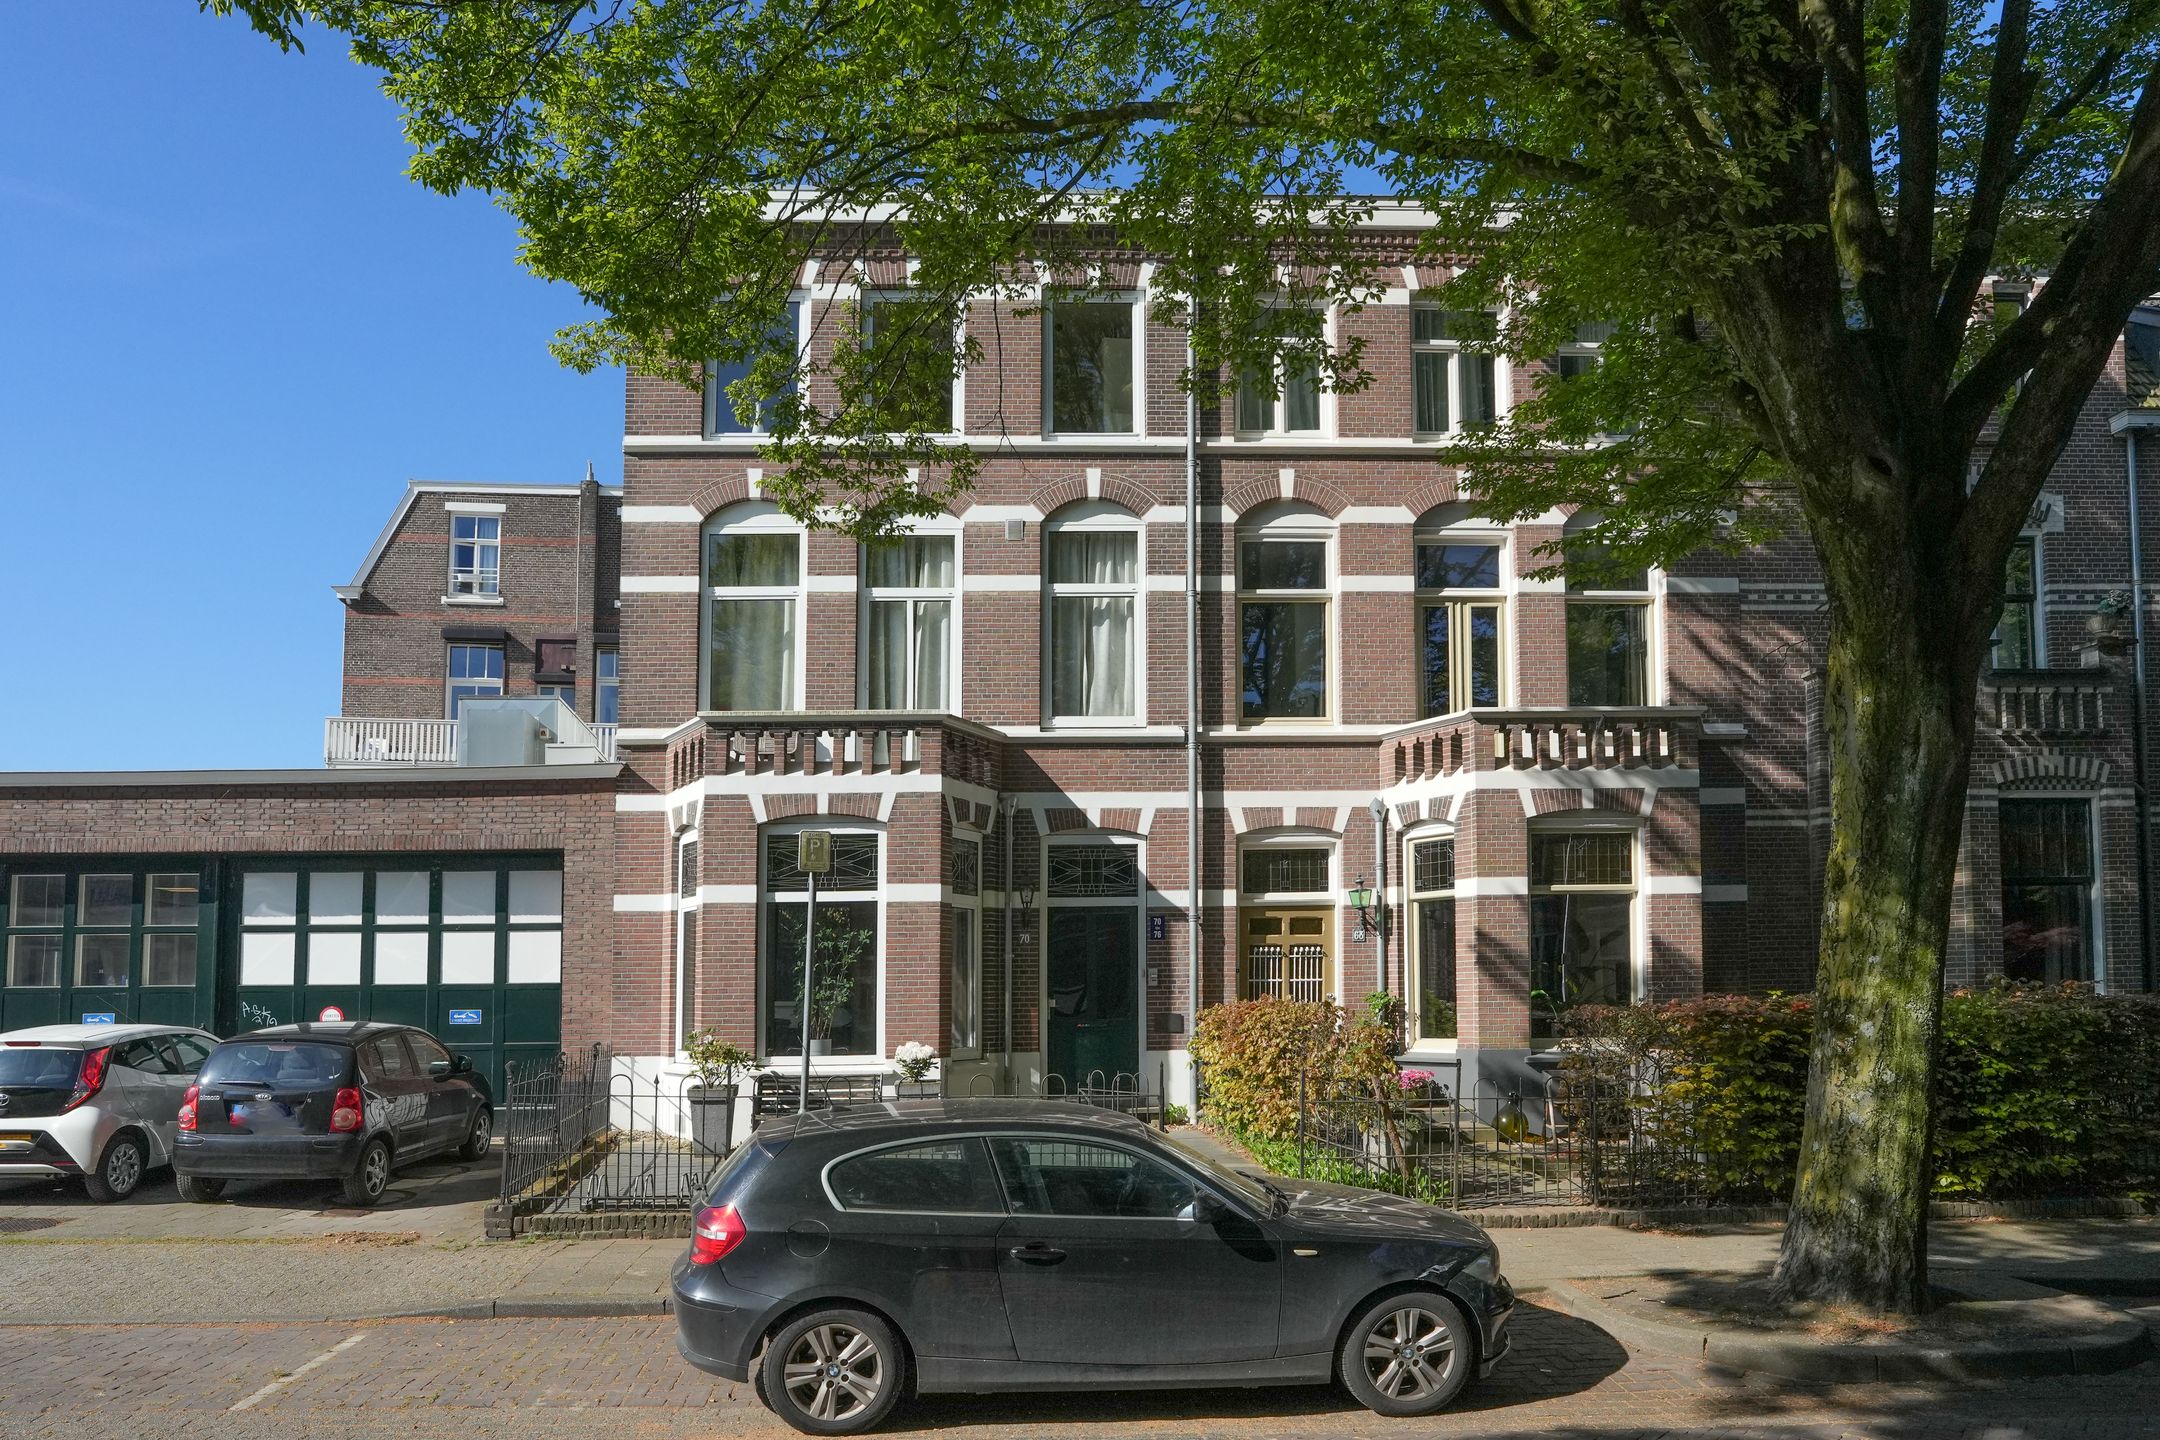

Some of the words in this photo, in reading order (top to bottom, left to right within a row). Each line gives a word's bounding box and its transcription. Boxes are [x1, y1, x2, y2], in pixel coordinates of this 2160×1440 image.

[810, 839, 820, 852] P
[1153, 917, 1162, 926] 70
[1020, 934, 1030, 943] 70
[1153, 930, 1162, 939] 76
